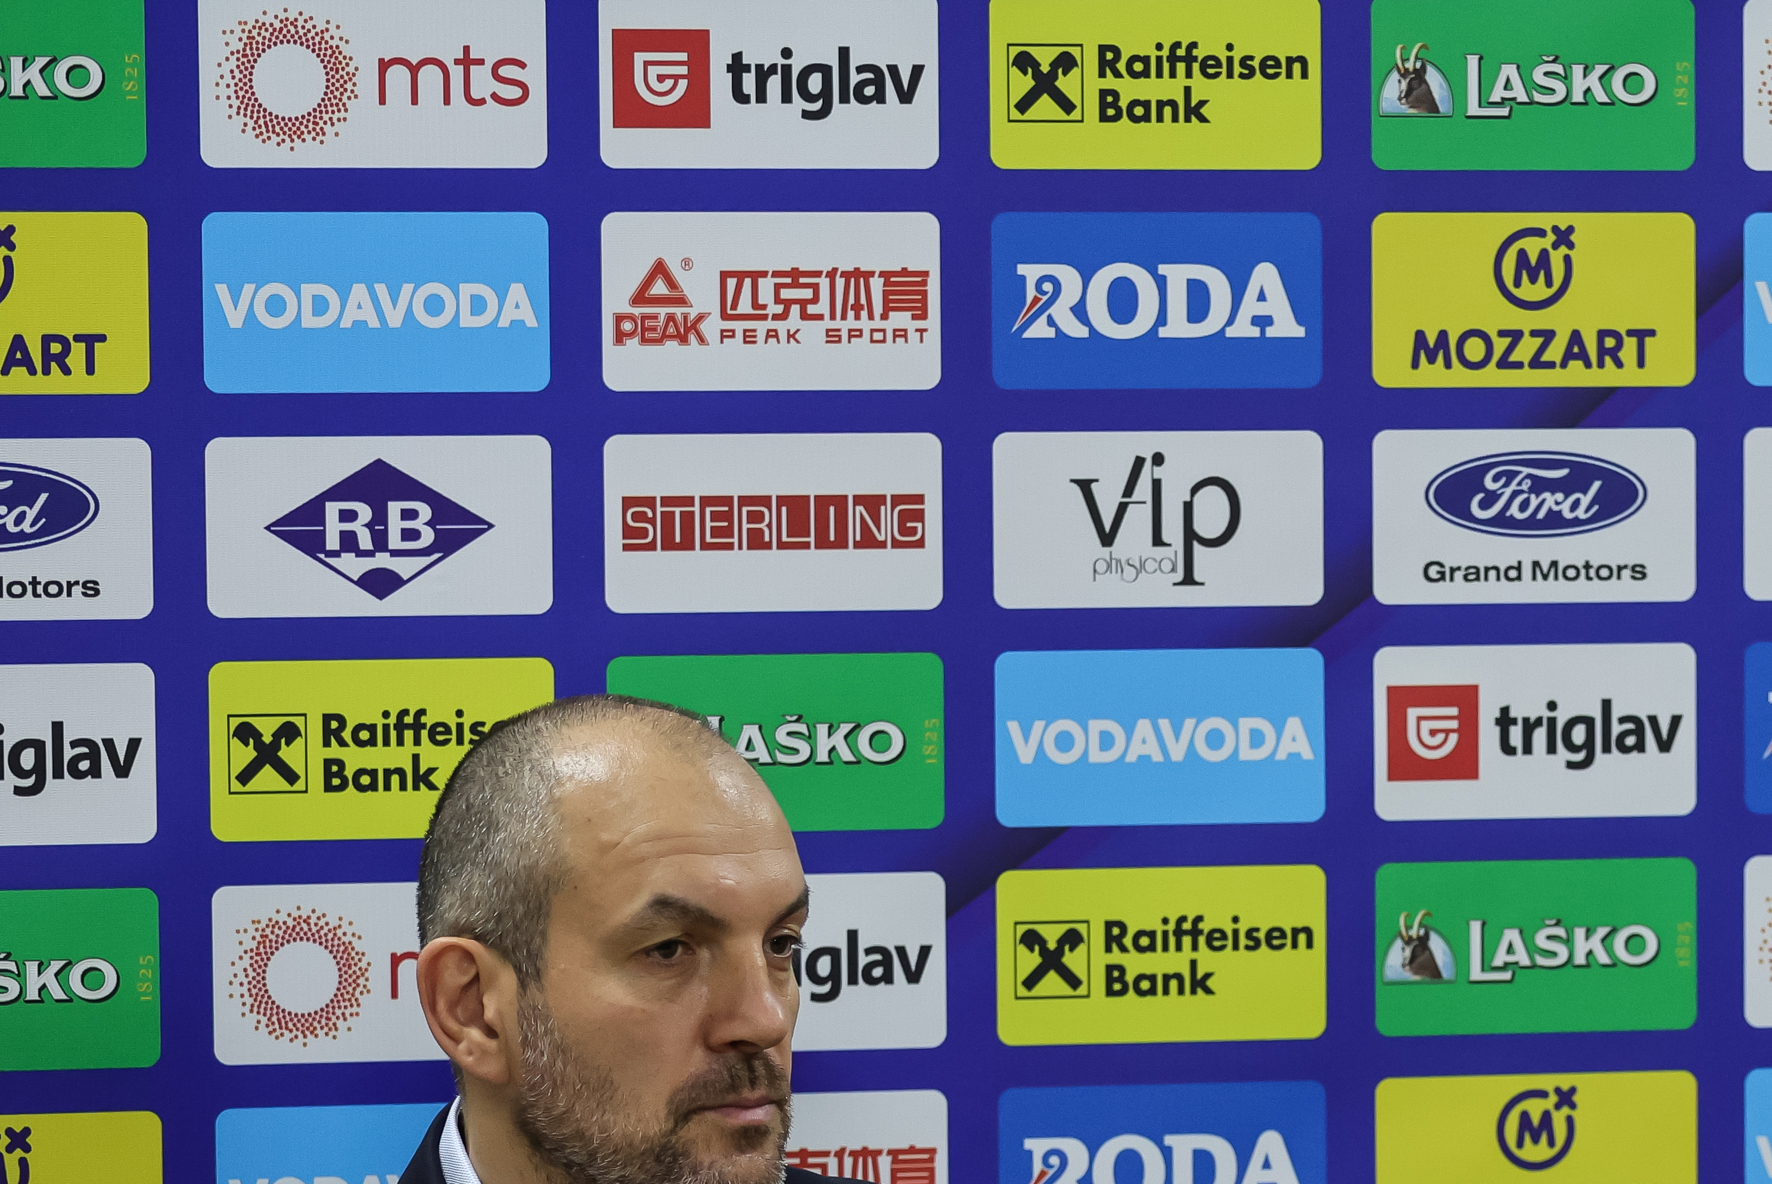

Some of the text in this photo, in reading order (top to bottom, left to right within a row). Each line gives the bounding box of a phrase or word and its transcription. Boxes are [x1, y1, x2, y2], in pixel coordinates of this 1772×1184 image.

[0, 55, 105, 102] KO
[378, 45, 529, 107] mts
[1098, 41, 1308, 80] Raiffeisen
[727, 46, 925, 120] triglav
[1099, 86, 1210, 124] Bank
[215, 282, 538, 329] VODAVODA
[719, 268, 929, 322] 匹克体育
[1011, 261, 1305, 341] RODA
[613, 313, 710, 346] PEAK
[720, 328, 928, 344] PEAK SPORT
[1411, 329, 1656, 370] MOZZART
[1470, 467, 1601, 520] Ford
[622, 494, 925, 552] STERLING
[1092, 550, 1178, 583] physical
[1423, 560, 1647, 583] Grand Motors
[322, 708, 487, 747] Raiffeis
[706, 714, 906, 767] AŠKO
[1007, 717, 1314, 764] VODAVODA
[1495, 699, 1682, 770] triglav
[323, 753, 440, 793] Bank
[1104, 915, 1313, 953] Raiffeisen
[1105, 959, 1215, 997] Bank
